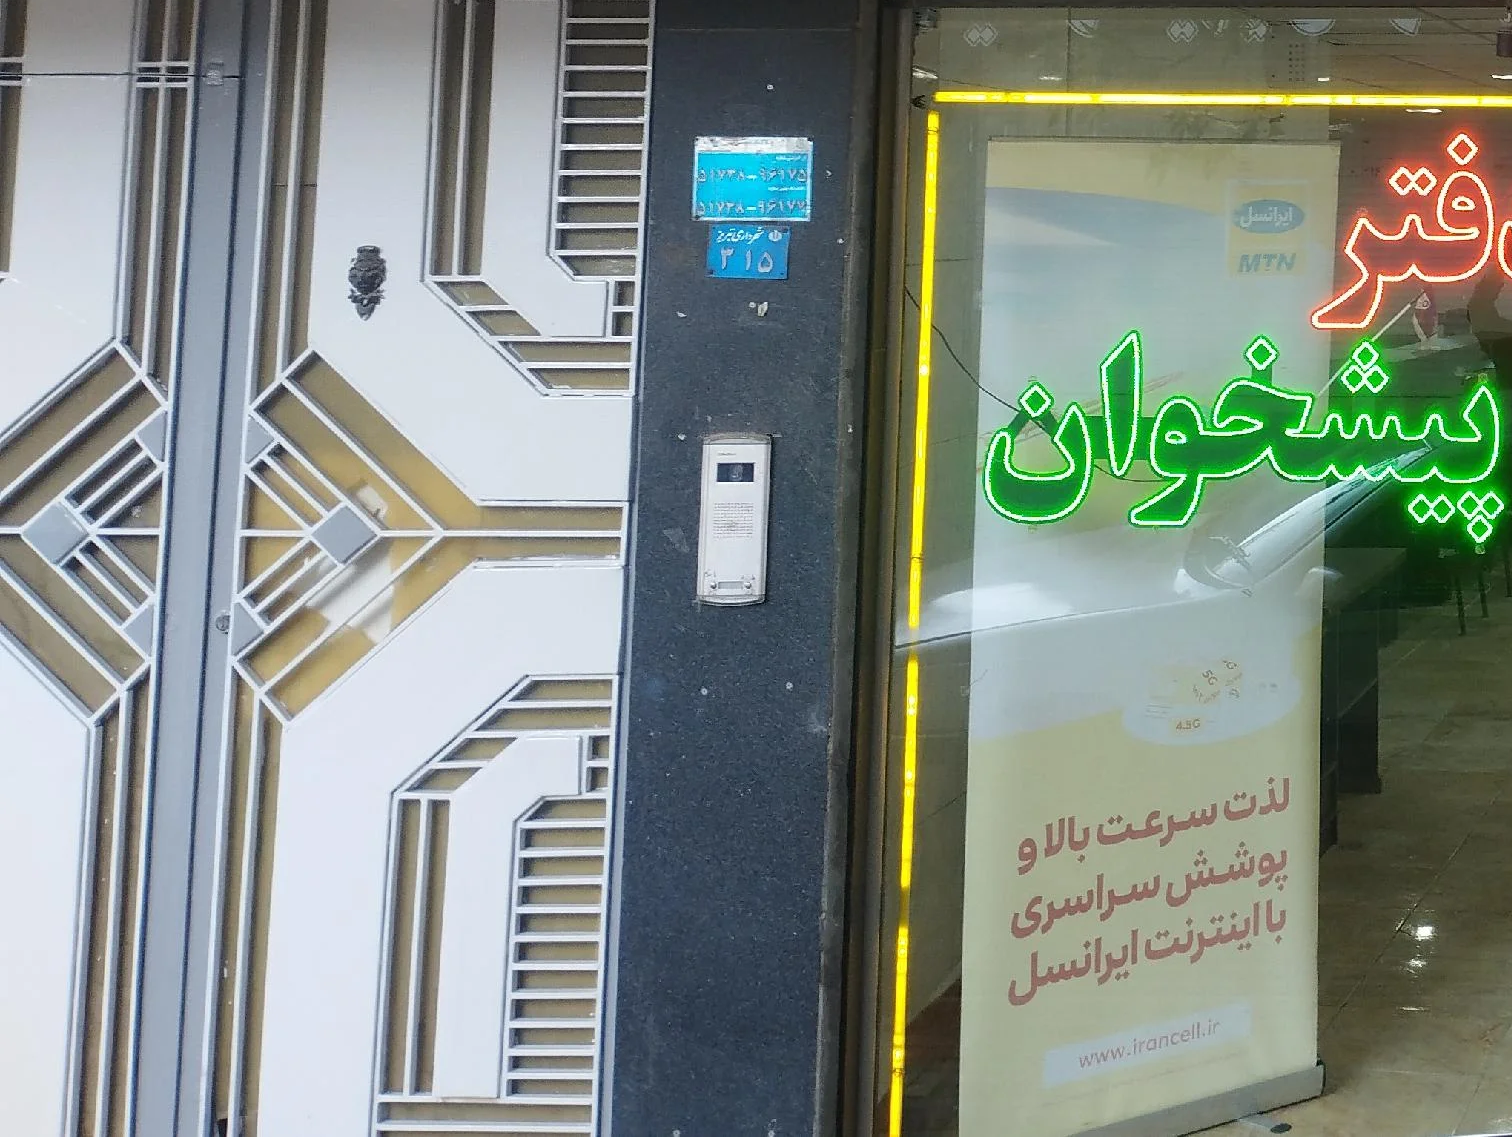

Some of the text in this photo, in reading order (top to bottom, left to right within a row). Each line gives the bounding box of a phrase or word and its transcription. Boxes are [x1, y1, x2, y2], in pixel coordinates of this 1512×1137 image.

[1238, 205, 1295, 229] ایرانسل
[719, 246, 775, 274] ۳۱۵
[1239, 253, 1298, 273] MTN
[983, 329, 1506, 545] پیشخوان
[1017, 776, 1290, 876] لذت سرعت بالا و
[1010, 840, 1288, 939] پوشش سراسری
[1008, 897, 1287, 1007] با اینترنت ایرانسل
[1078, 1017, 1222, 1069] www.irancell.ir
